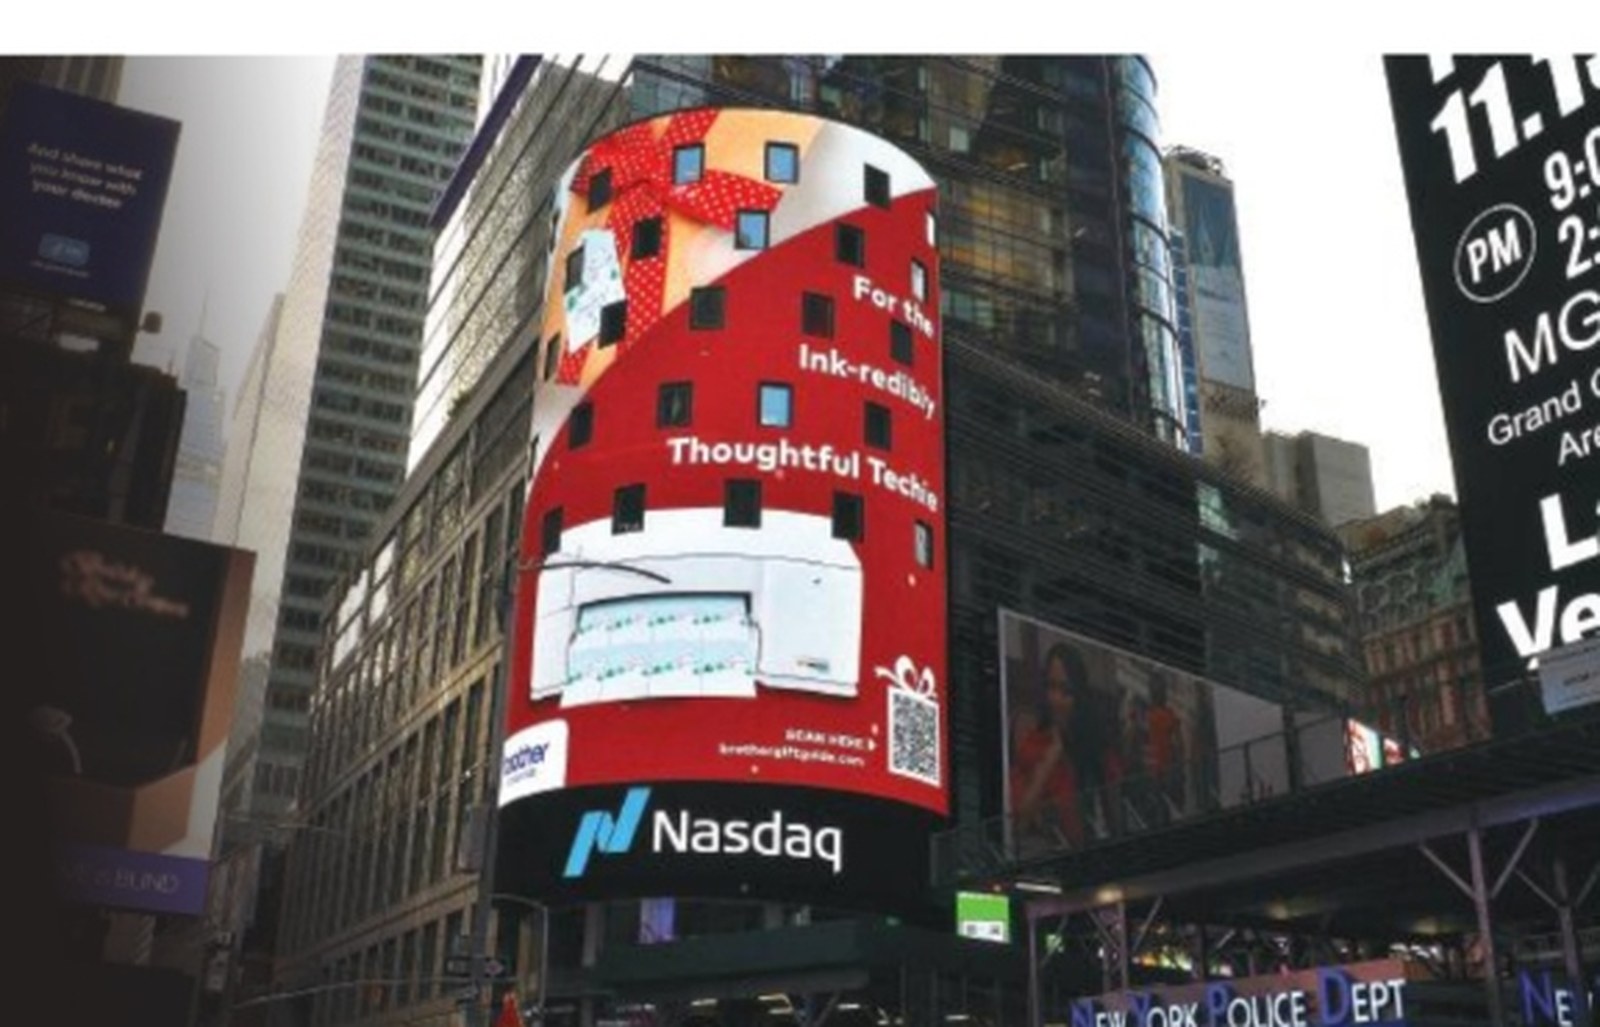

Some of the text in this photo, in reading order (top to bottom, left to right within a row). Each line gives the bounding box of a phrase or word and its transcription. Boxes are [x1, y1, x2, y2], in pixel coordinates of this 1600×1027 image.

[32, 178, 68, 197] your
[61, 152, 103, 170] share
[105, 163, 143, 181] what
[1466, 217, 1522, 284] PM
[852, 275, 934, 339] For the
[799, 342, 936, 420] Ink-redibly
[1487, 379, 1583, 446] Grand
[666, 436, 938, 512] Thoughtful Techie
[1540, 493, 1600, 571] L
[784, 727, 826, 744] SCAN
[651, 810, 844, 874] Nasdaq
[1206, 980, 1308, 1027] POLICE
[1316, 965, 1407, 1025] DEPT
